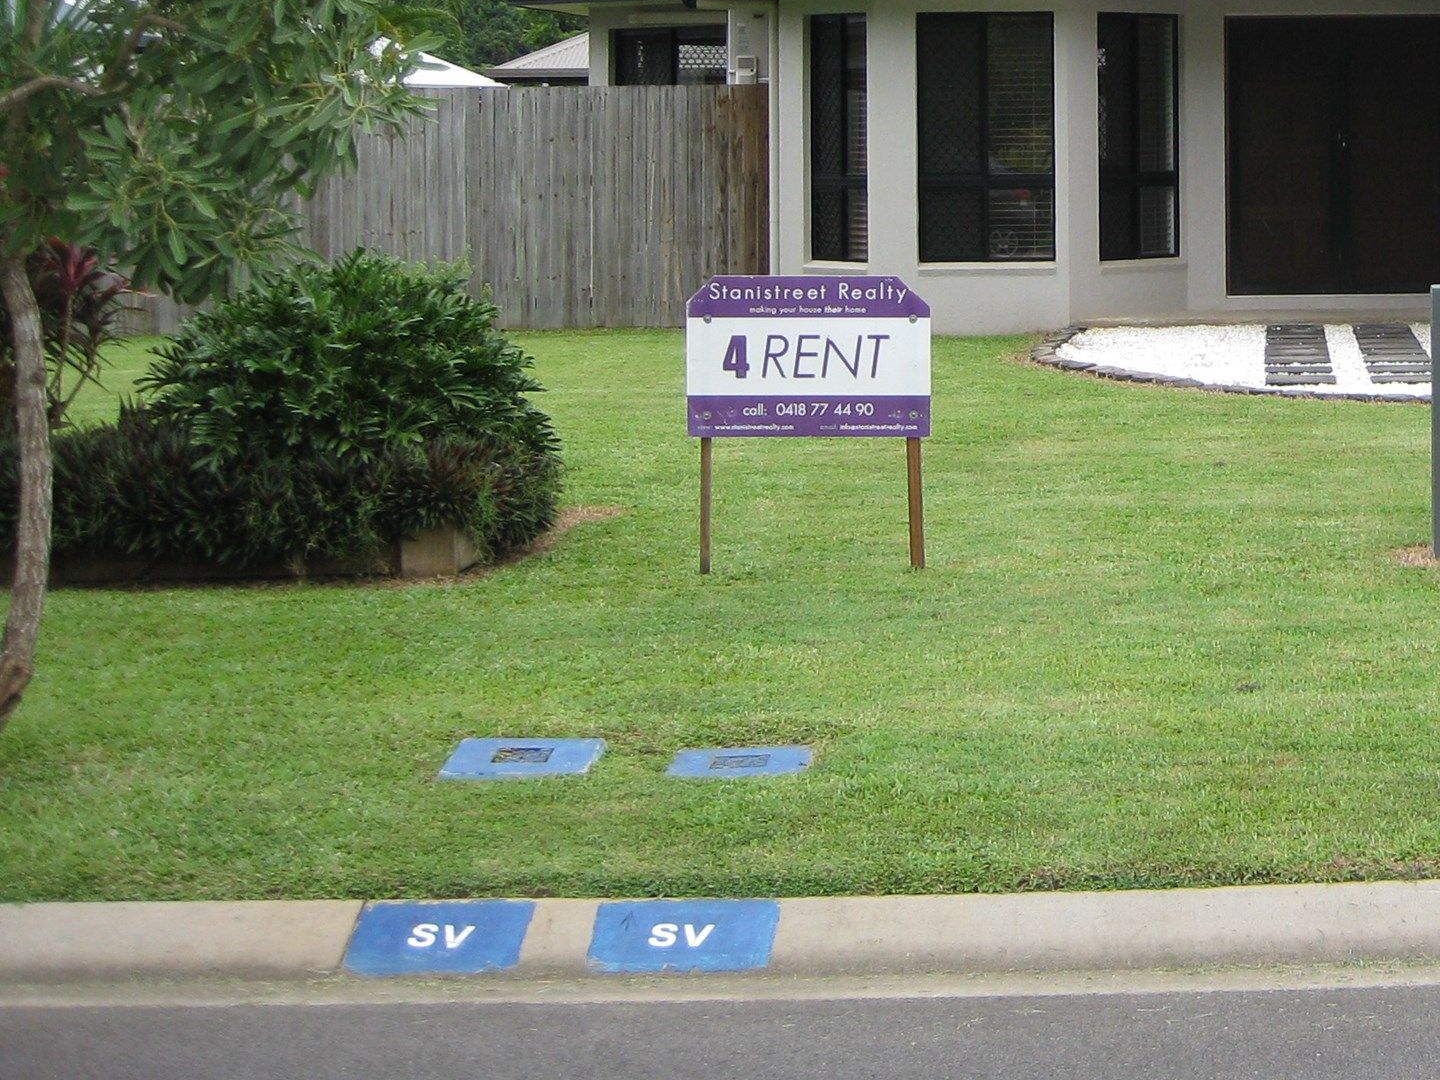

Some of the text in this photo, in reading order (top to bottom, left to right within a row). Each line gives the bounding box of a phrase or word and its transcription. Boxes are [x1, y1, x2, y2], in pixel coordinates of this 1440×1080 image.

[709, 283, 907, 303] Stanistreet Realty
[749, 305, 867, 314] making your house their home
[722, 334, 890, 379] 4 RENT
[742, 403, 874, 417] call: 0418 77 44 90
[407, 923, 475, 949] SV
[647, 923, 716, 948] SV
